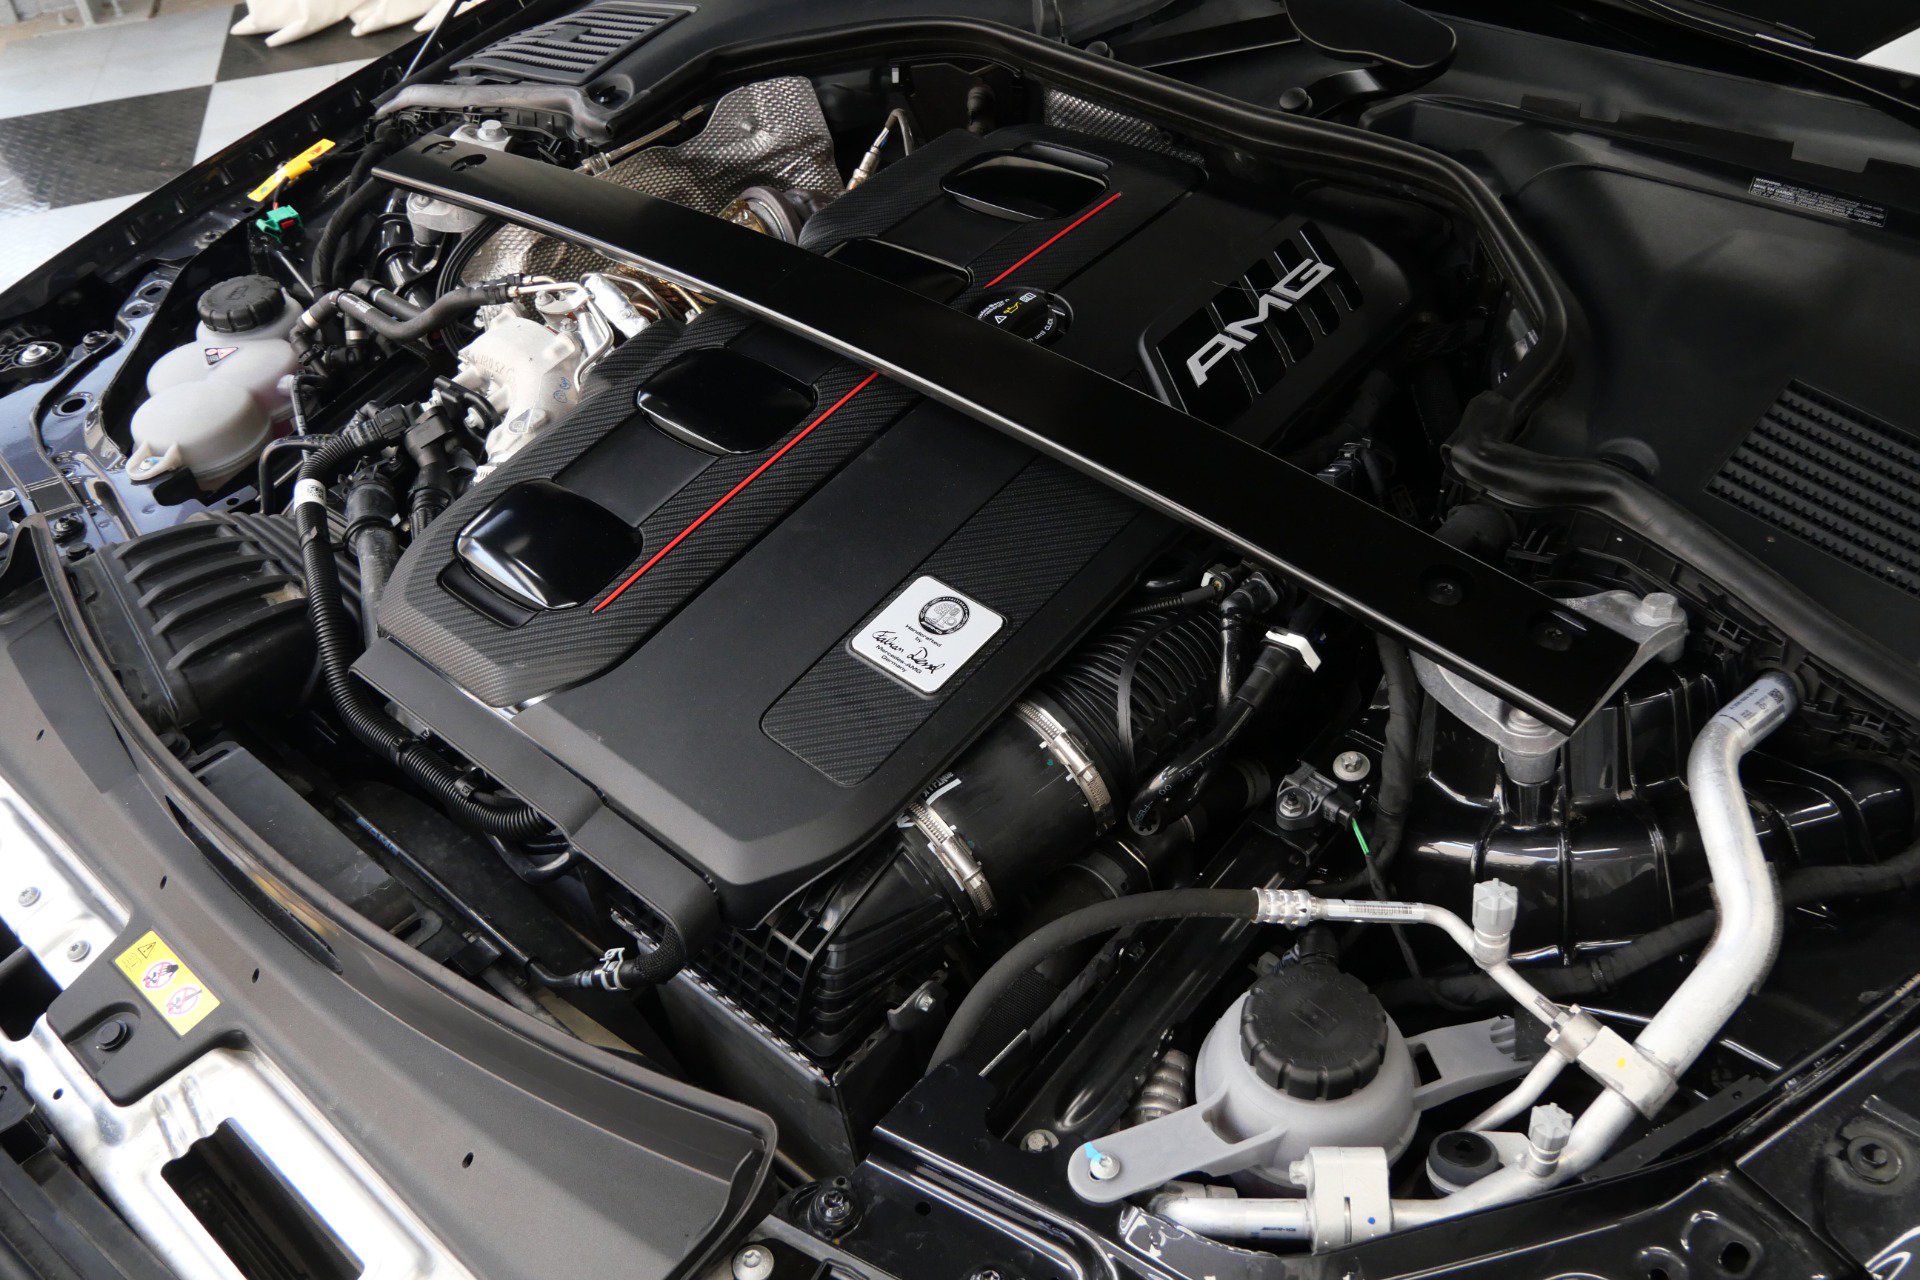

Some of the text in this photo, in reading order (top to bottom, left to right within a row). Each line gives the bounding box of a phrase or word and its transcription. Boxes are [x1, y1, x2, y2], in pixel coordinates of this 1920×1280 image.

[1186, 258, 1336, 388] AMG
[905, 624, 942, 648] Handcrafted
[875, 645, 922, 674] Mercedes-AMG
[881, 655, 907, 673] Germany
